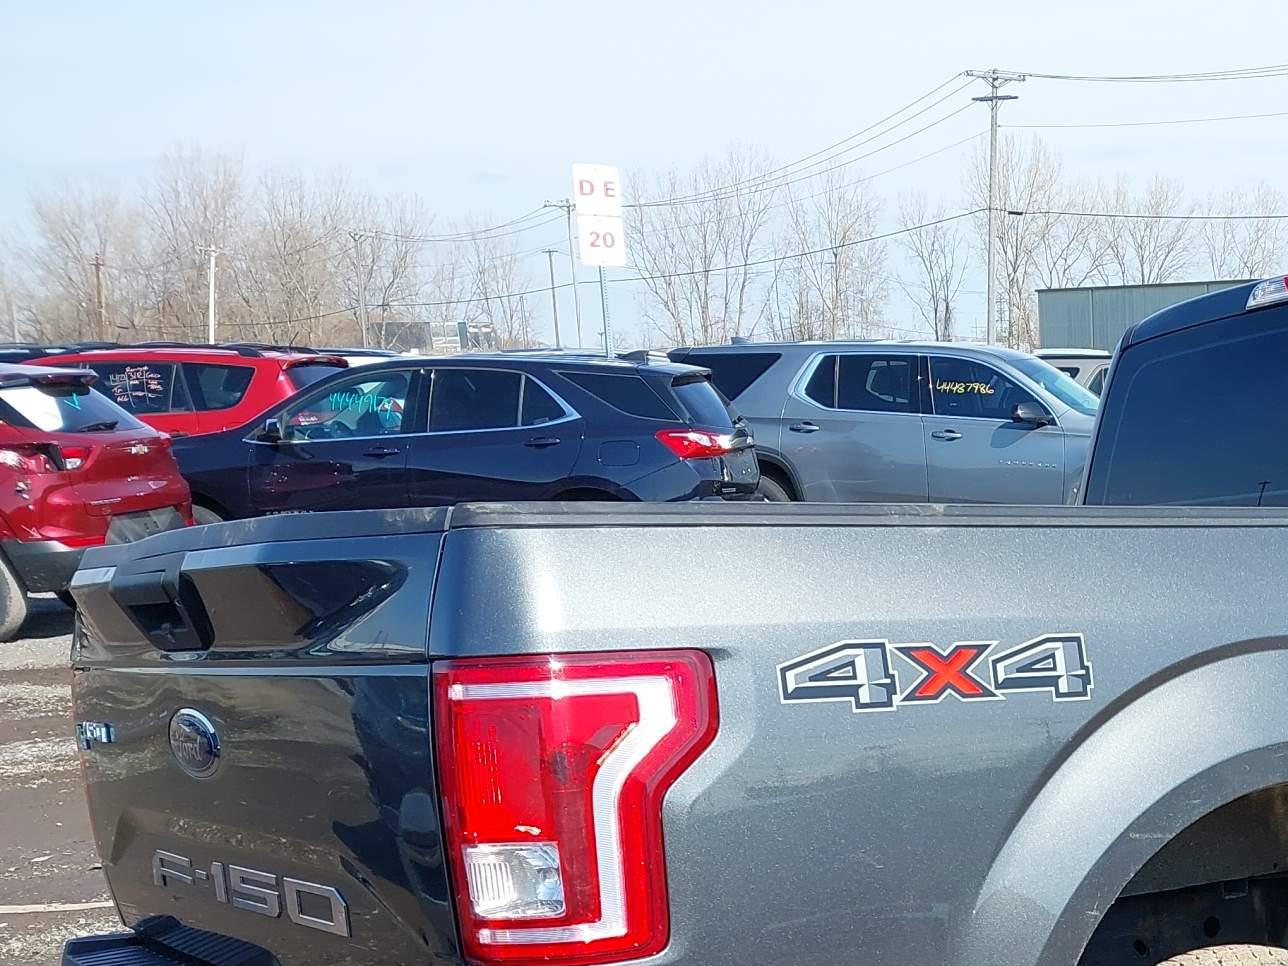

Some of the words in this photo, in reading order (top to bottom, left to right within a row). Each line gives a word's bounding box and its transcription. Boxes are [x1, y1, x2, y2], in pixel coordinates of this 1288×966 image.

[589, 231, 616, 248] 20
[936, 377, 995, 394] 44487986
[153, 849, 352, 938] F-150
